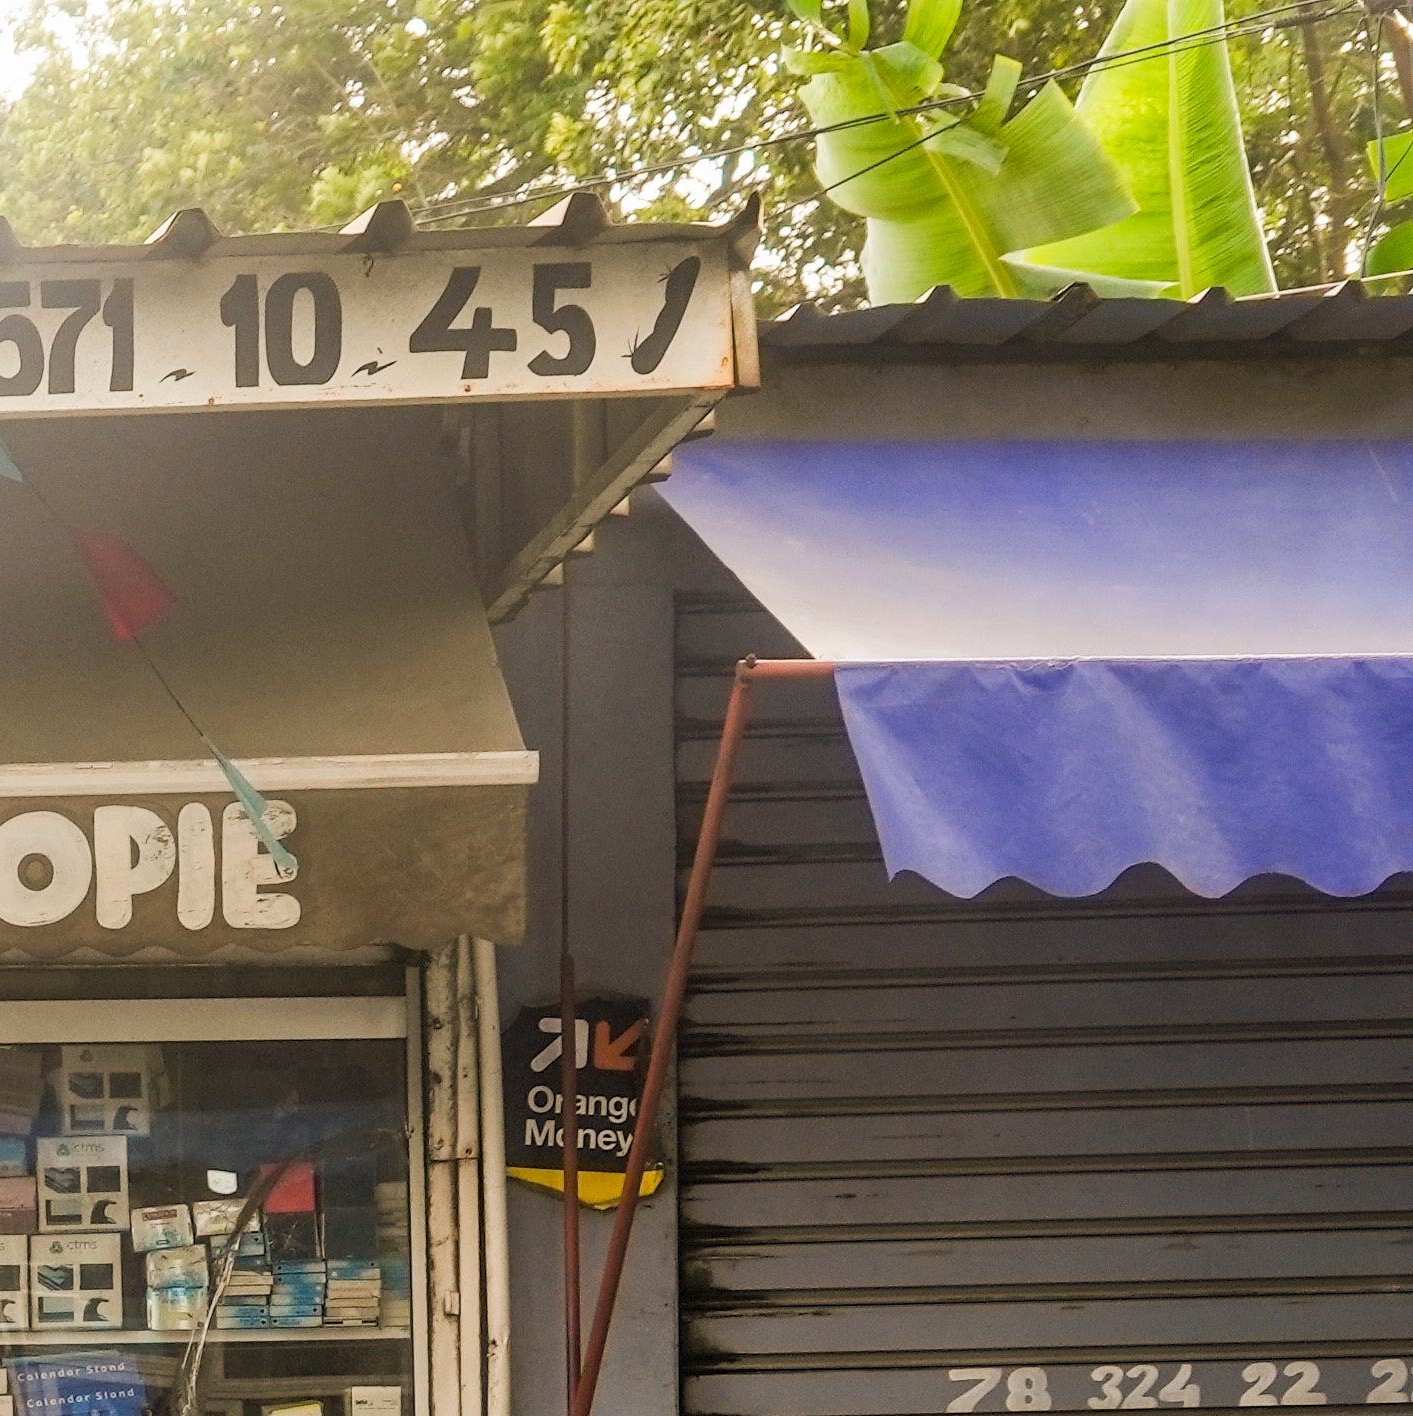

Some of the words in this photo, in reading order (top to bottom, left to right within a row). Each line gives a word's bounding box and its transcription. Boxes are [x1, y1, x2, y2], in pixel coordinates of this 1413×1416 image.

[16, 1366, 80, 1382] Calendar
[86, 1362, 126, 1375] Stand
[947, 1366, 1052, 1414] 78
[1086, 1363, 1201, 1410] 324
[1239, 1360, 1328, 1406] 22
[1366, 1358, 1413, 1405] 2
[26, 1393, 90, 1408] Calendar
[95, 1388, 135, 1400] Stand
